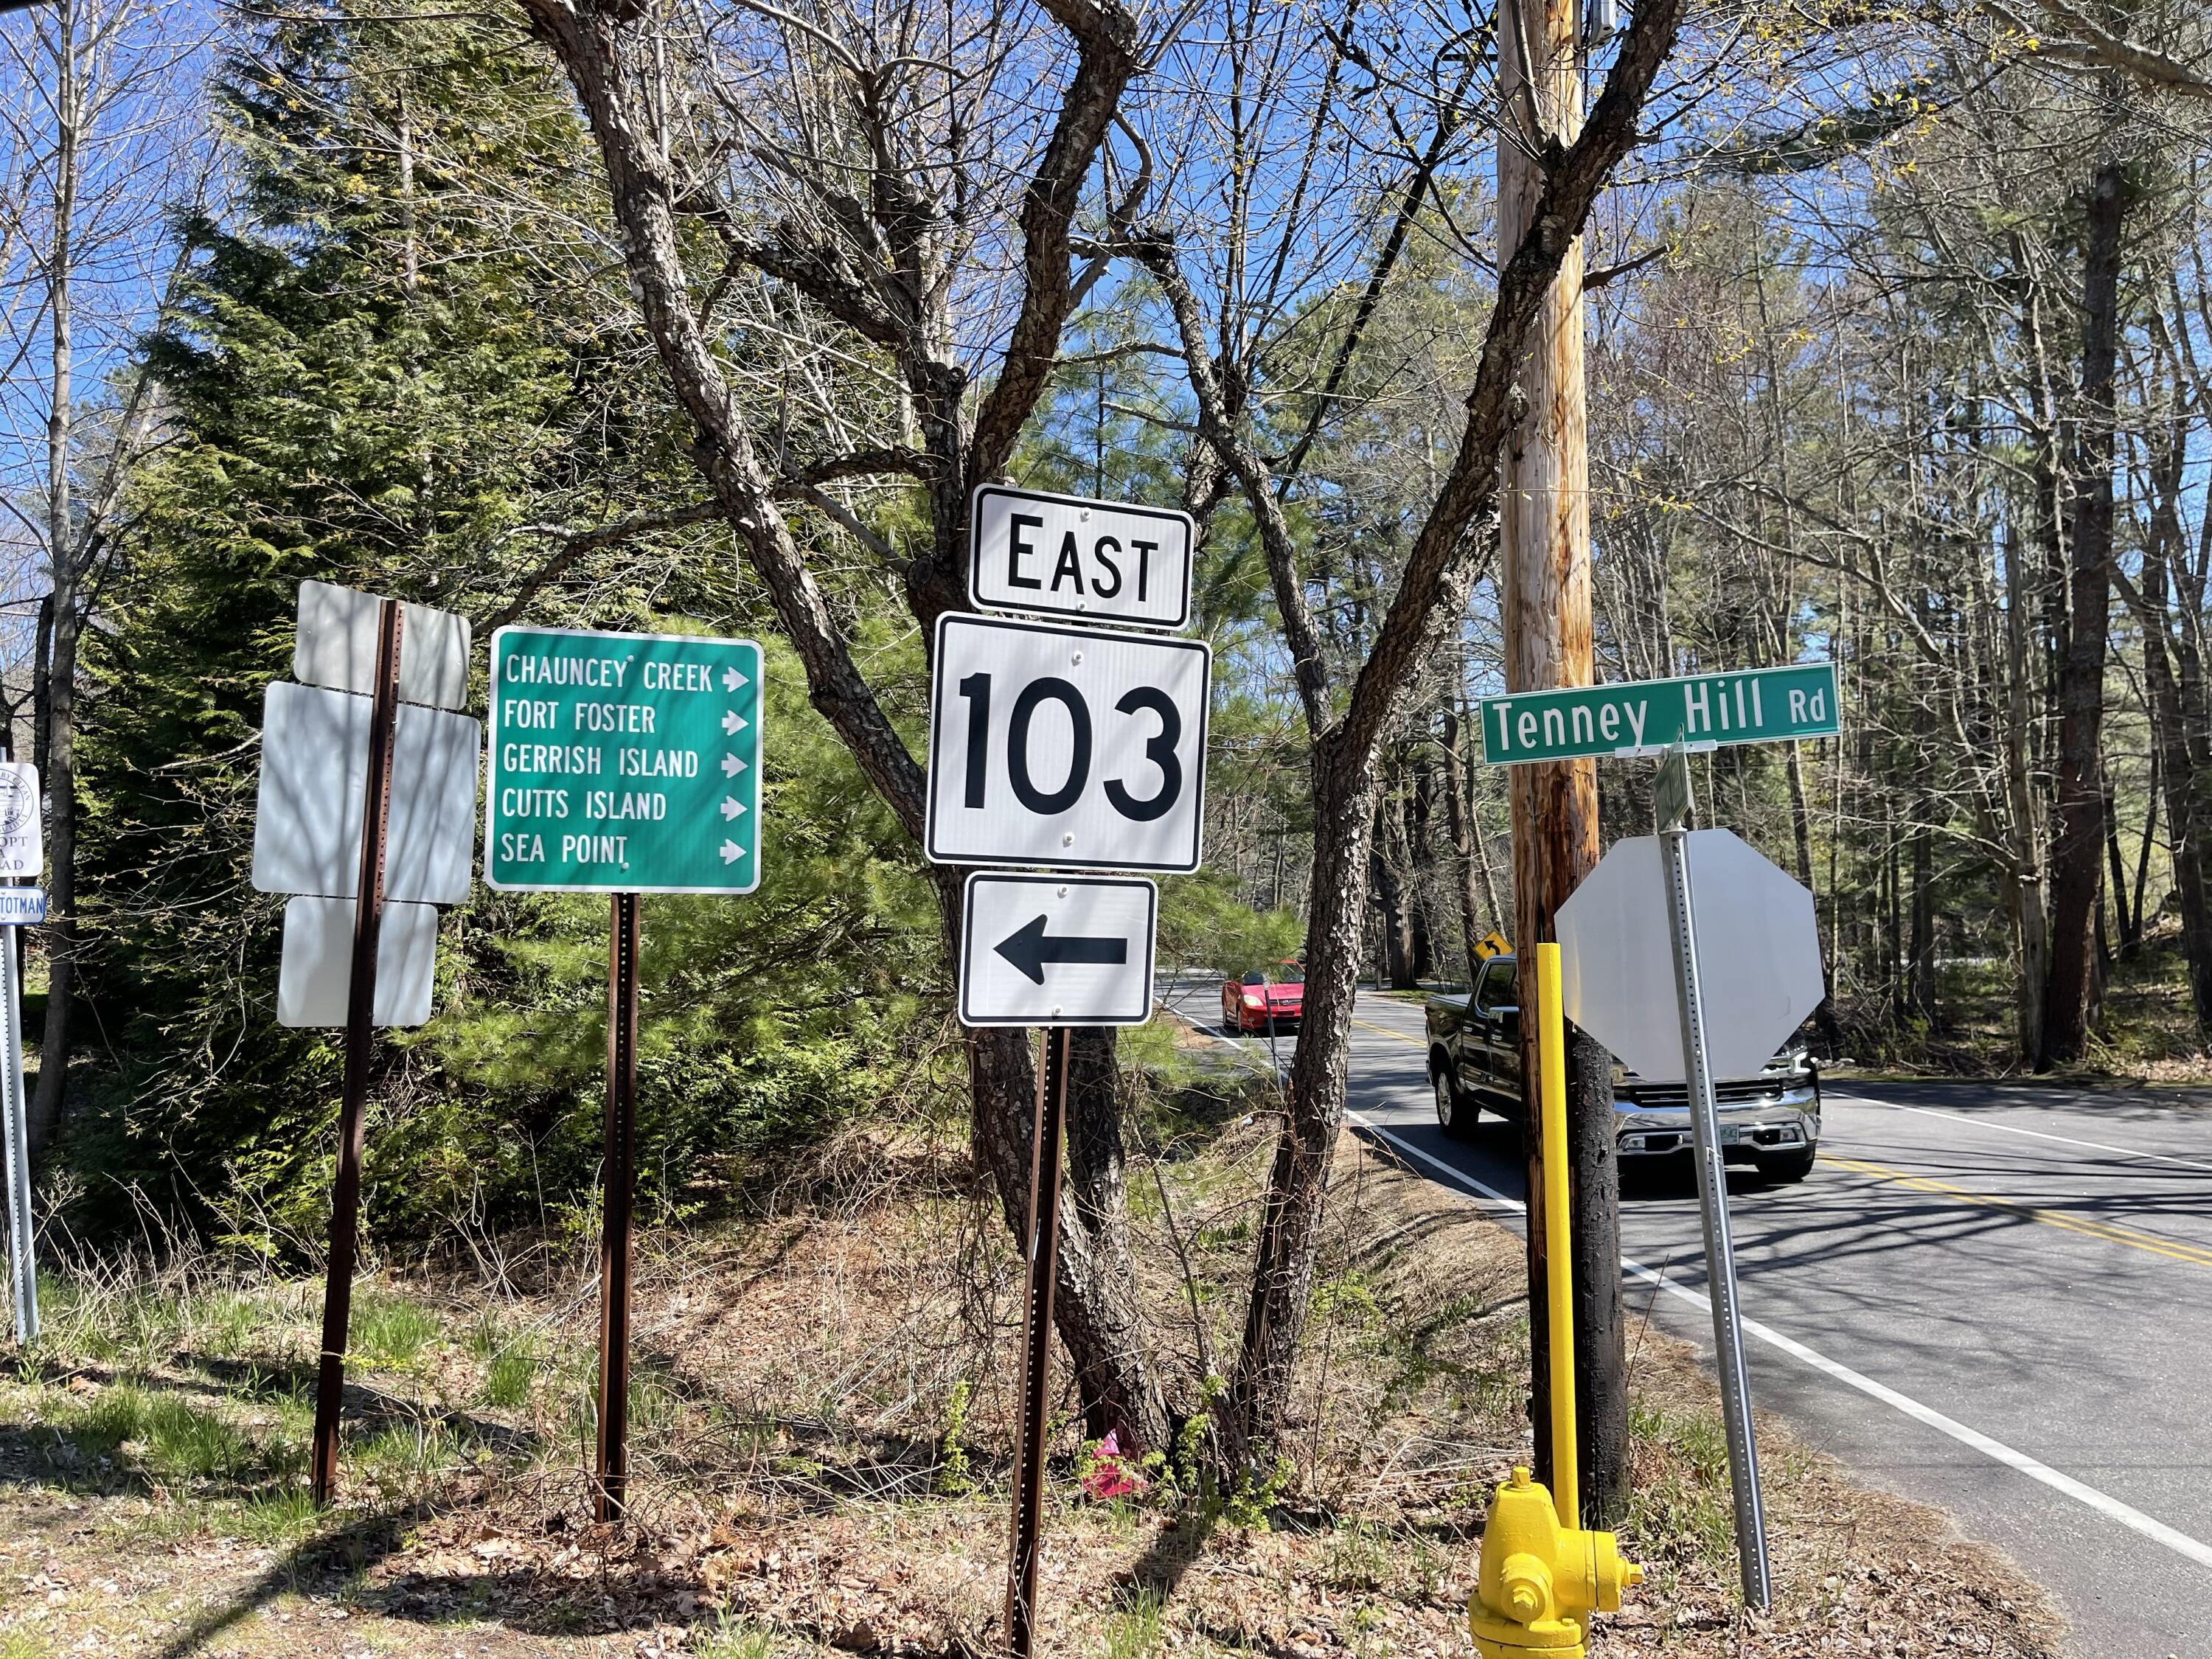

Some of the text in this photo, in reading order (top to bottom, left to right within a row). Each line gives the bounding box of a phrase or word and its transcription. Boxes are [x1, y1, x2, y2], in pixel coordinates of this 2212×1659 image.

[1007, 512, 1159, 602] EAST
[506, 654, 713, 692] CHAUNCEY CREEK
[504, 699, 655, 734] FORT FOSTER
[1492, 677, 1826, 751] Tenney Hill Rd
[504, 743, 698, 778] GERRISH ISLAND
[959, 672, 1183, 822] 103
[502, 787, 667, 821] CUTTS ISLAND
[0, 813, 28, 832] UTIFUL
[0, 860, 24, 870] AD
[501, 833, 627, 864] SEA POINT
